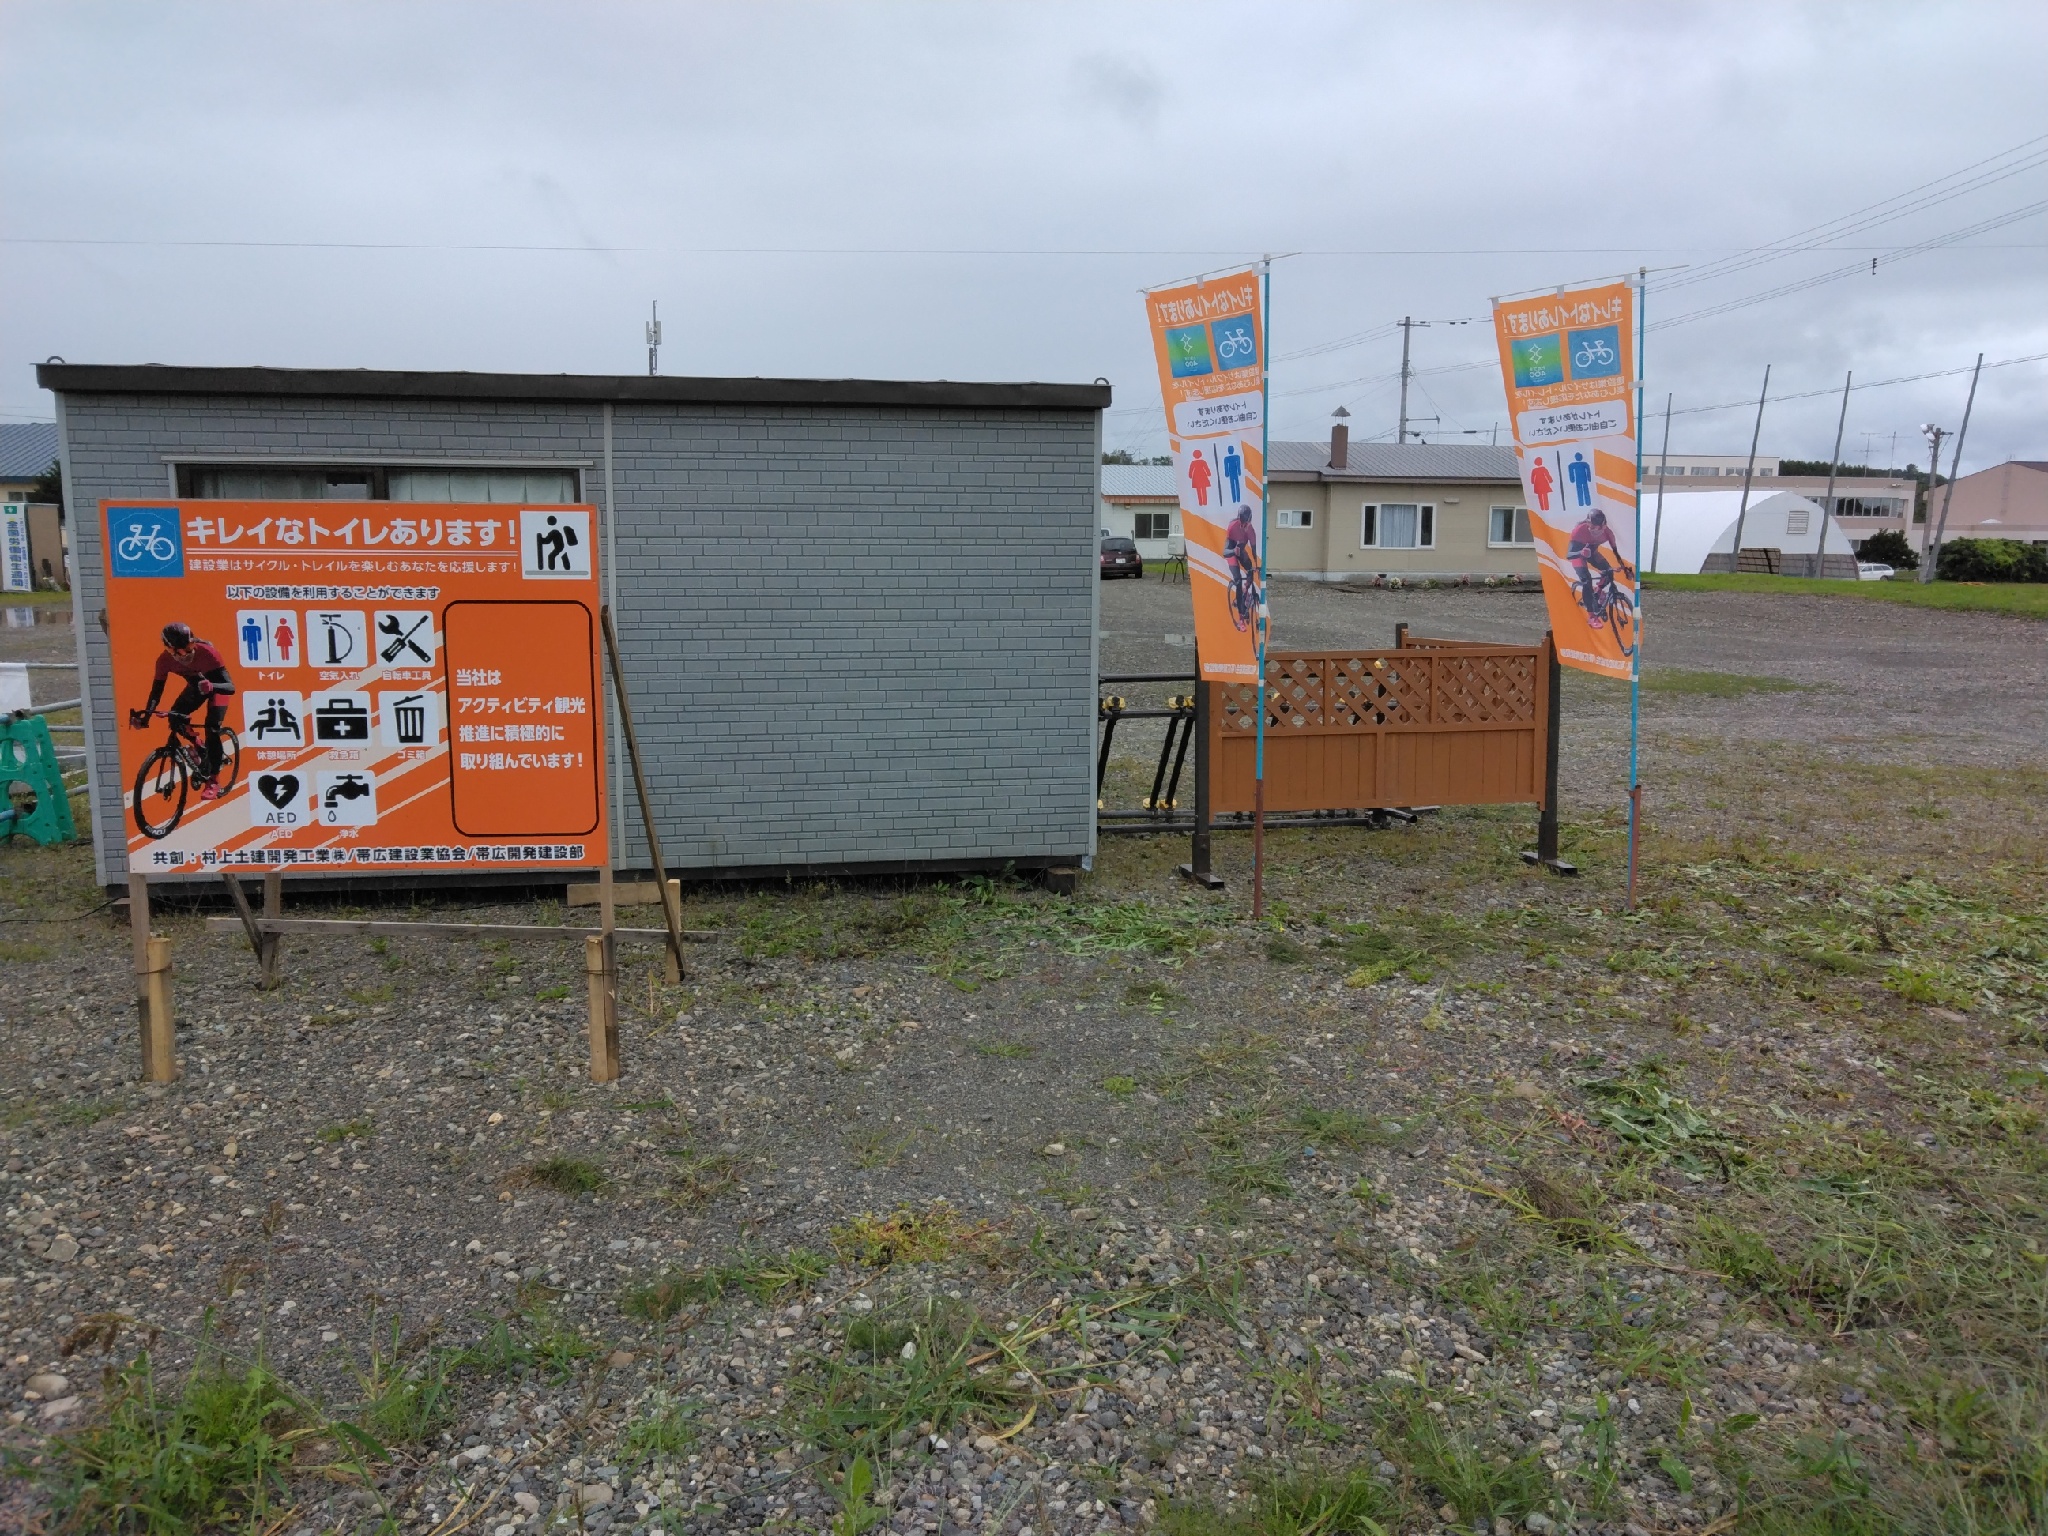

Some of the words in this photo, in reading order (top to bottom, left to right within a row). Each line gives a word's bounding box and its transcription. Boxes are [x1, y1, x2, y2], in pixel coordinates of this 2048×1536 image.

[186, 516, 517, 546] キレイなトイレあります！
[188, 558, 518, 574] 建設業はサイクル・トレイルを楽しむあなたを応援します！
[226, 585, 441, 600] 以下の設備を利用することができます
[258, 671, 284, 681] トイレ
[319, 671, 360, 681] 空気入れ
[382, 670, 432, 681] 自転車工具
[456, 668, 502, 687] 当社は
[457, 696, 586, 714] アクティビティ観光
[459, 724, 565, 743] 推進に積極的に
[256, 750, 297, 760] 休憩場所
[397, 750, 427, 760] ゴミ箱
[460, 752, 583, 771] 取り組んでいます！
[265, 812, 297, 824] AED
[269, 829, 293, 838] AED
[339, 829, 359, 838] 浄水
